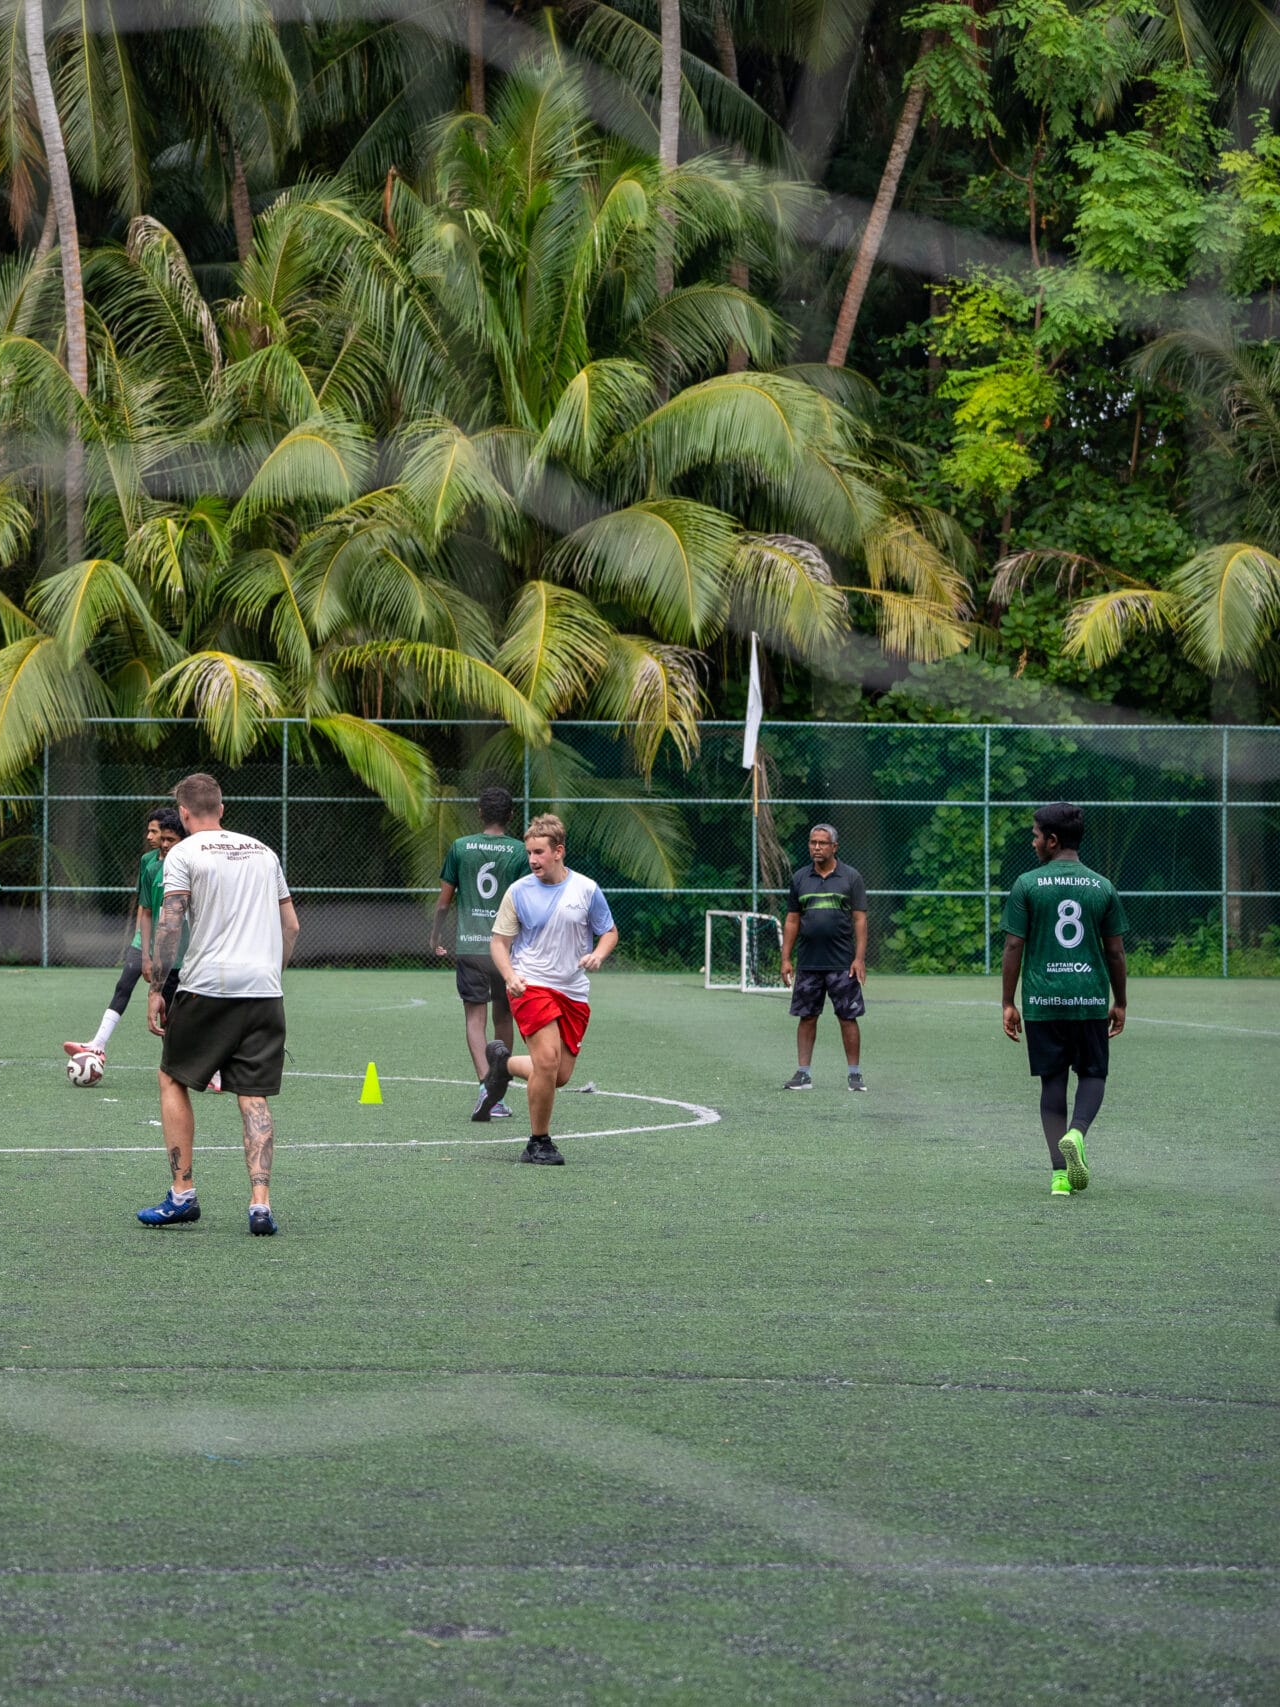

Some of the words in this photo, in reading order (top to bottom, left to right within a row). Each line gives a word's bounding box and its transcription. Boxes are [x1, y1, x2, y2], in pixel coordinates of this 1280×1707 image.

[466, 842, 478, 850] BAA
[478, 842, 506, 852] MAALHOS
[506, 844, 514, 854] SC
[477, 861, 498, 900] 6
[1037, 877, 1053, 886] BAA
[1054, 877, 1091, 887] MAALHOS
[1092, 879, 1101, 889] SC
[1055, 899, 1085, 949] 8
[460, 934, 493, 942] #VisitBaa
[1029, 996, 1106, 1006] #VisitBaaMaalhos
